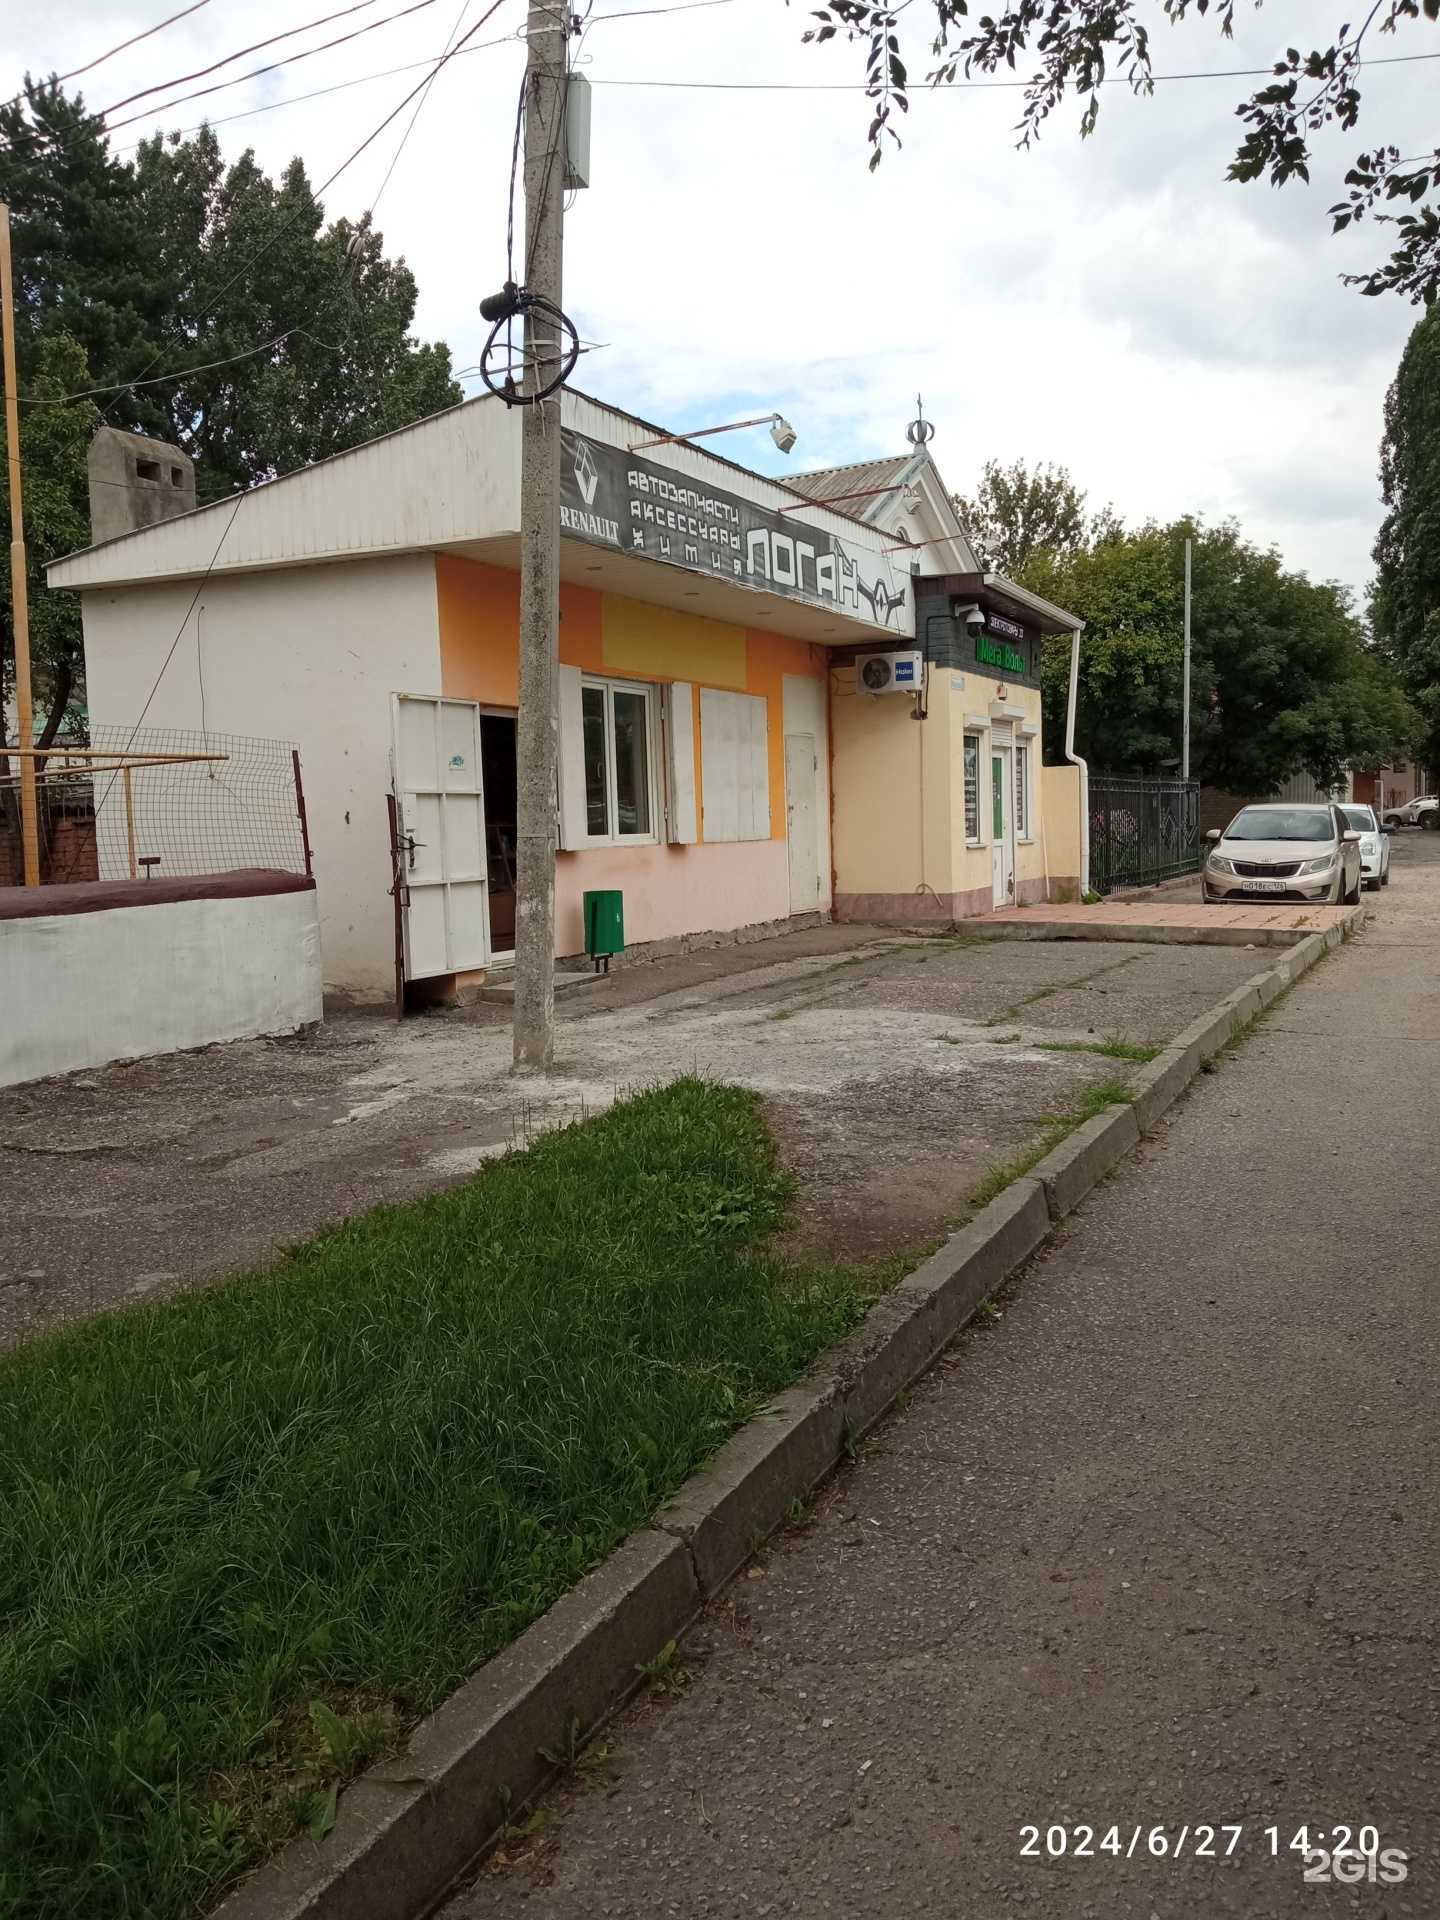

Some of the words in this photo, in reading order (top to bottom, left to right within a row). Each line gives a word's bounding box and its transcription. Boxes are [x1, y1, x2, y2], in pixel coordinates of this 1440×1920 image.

[559, 505, 619, 541] RENAULT
[627, 470, 740, 525] АВТОЗАПЧАСТИ
[630, 500, 741, 551] АКСЕССУАРЫ
[746, 528, 859, 609] ЛОГАН
